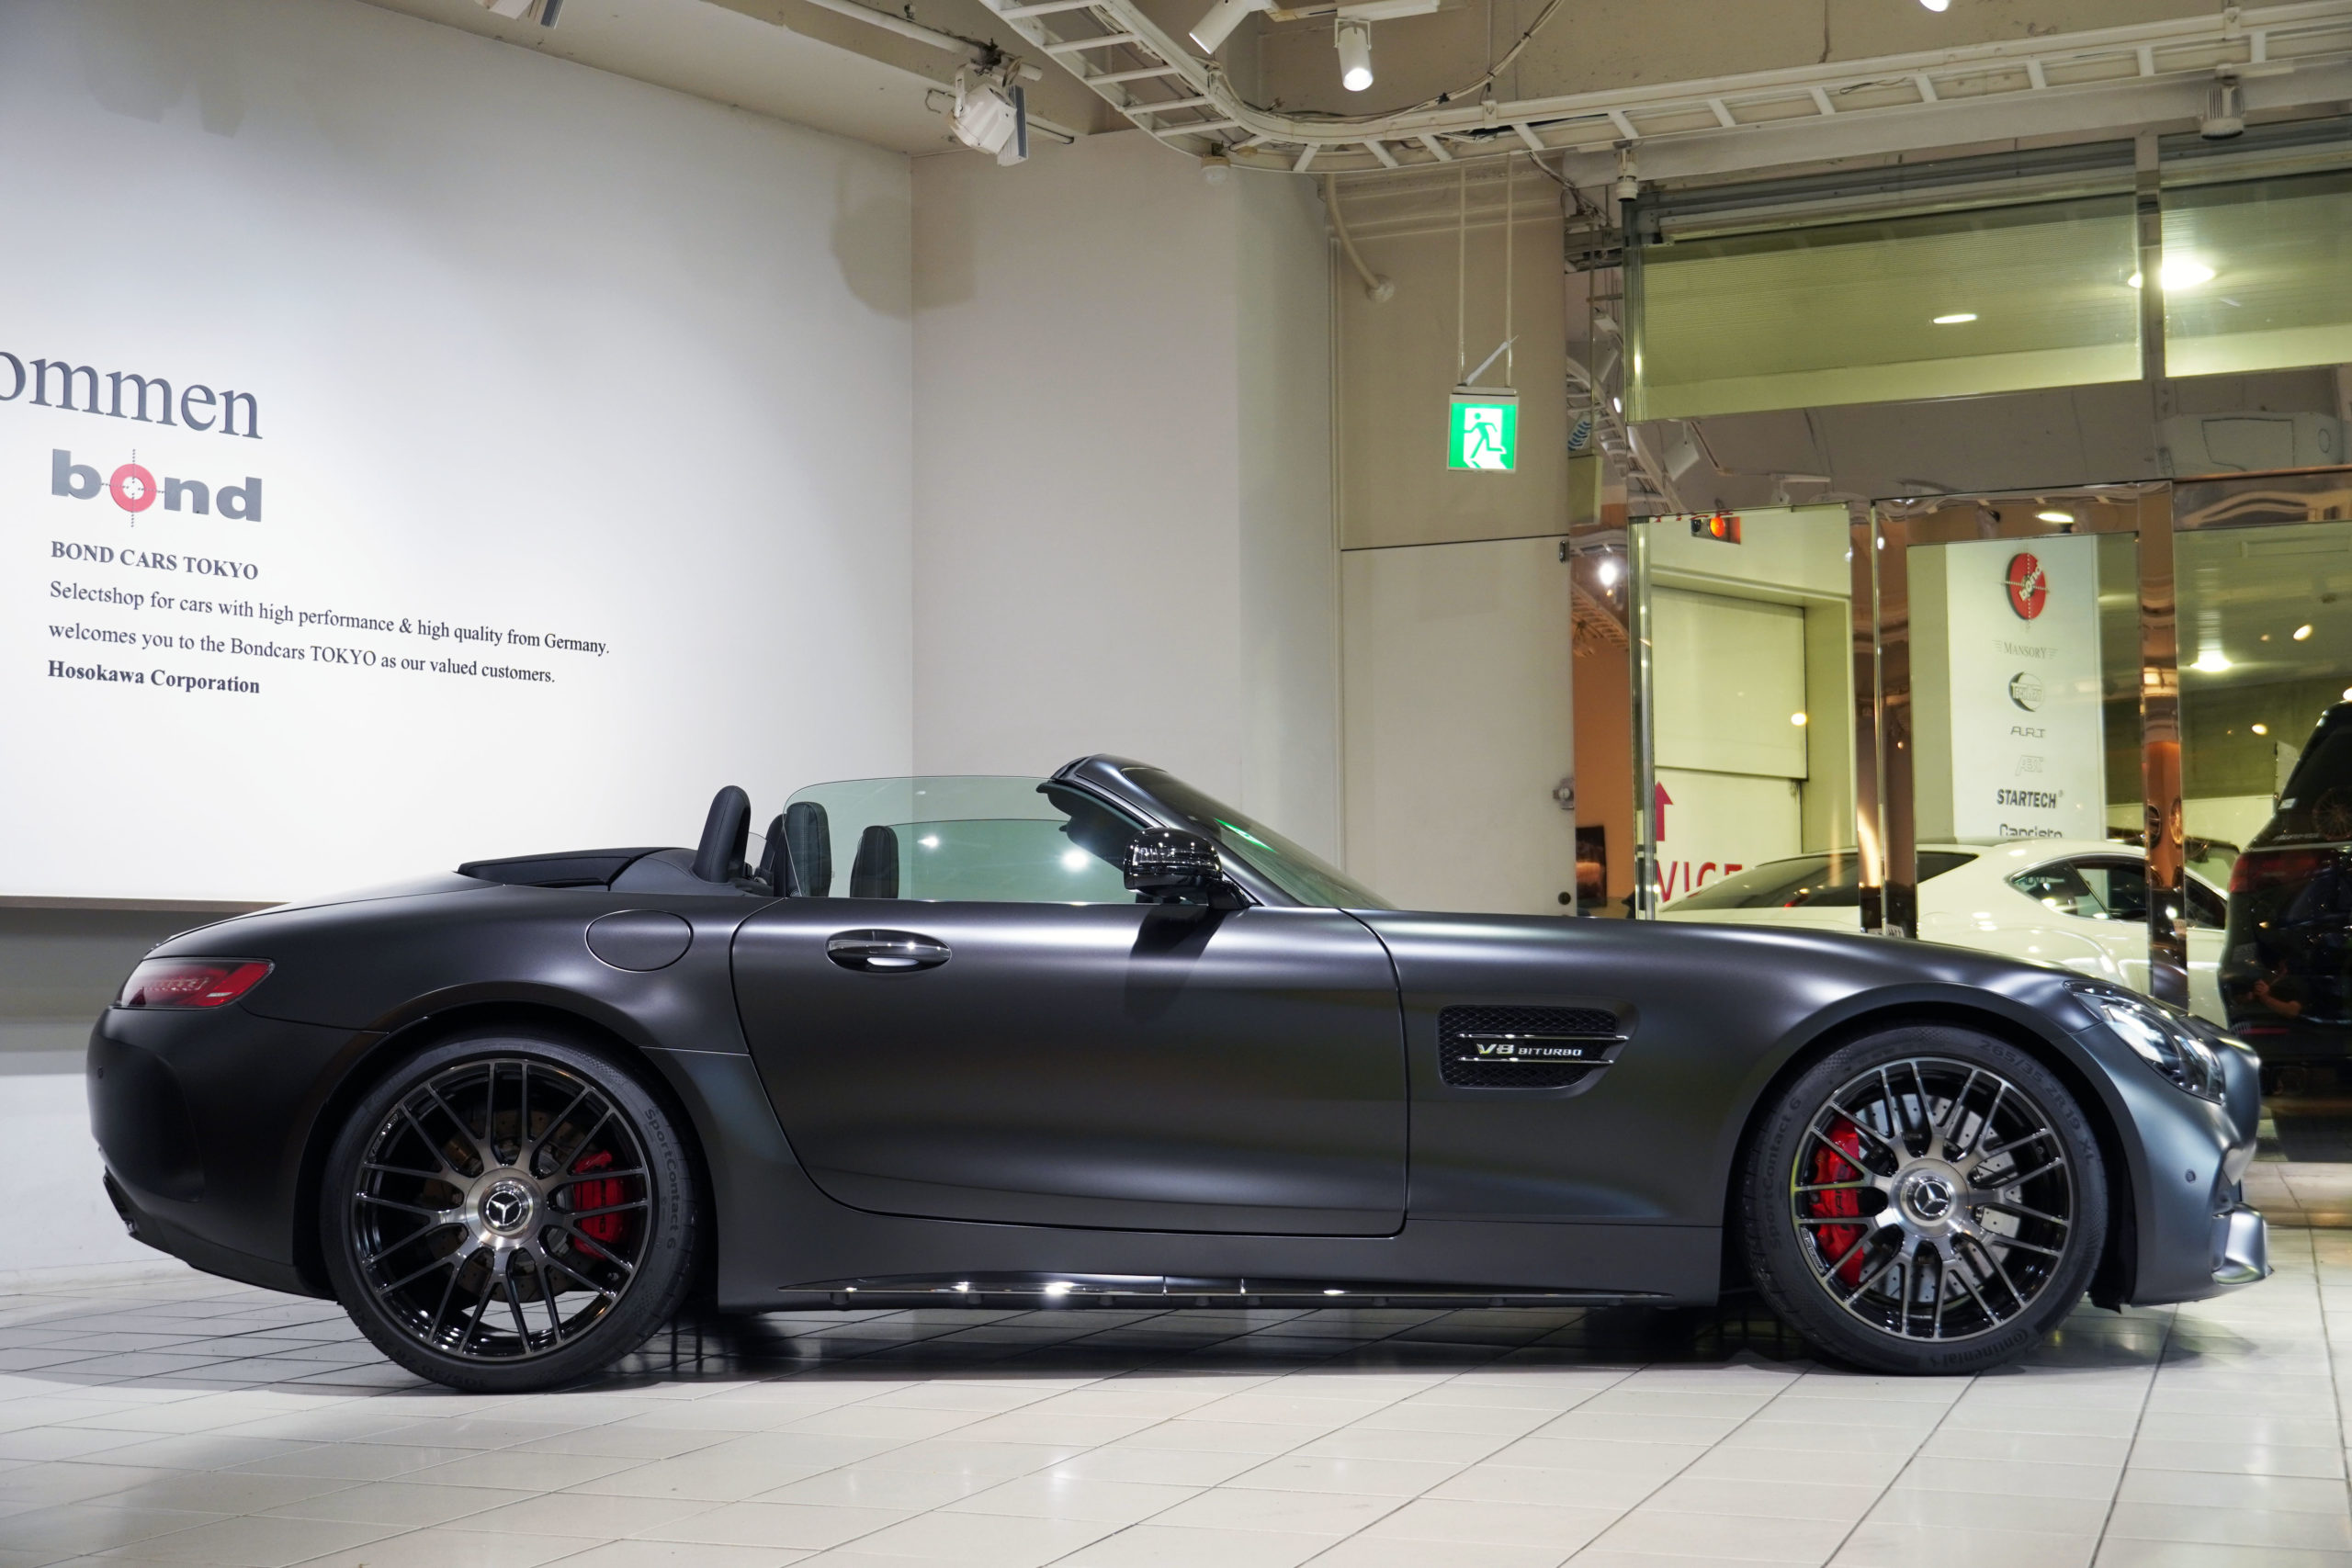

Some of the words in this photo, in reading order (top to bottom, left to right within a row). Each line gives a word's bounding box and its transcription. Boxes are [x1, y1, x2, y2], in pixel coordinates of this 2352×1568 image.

[51, 448, 262, 523] bond
[51, 540, 115, 564] BOND
[119, 548, 178, 571] CARS
[182, 556, 259, 581] TOKYO
[50, 580, 145, 611] Selectshop
[150, 591, 175, 610] for
[179, 599, 213, 614] cars
[218, 599, 254, 618] with
[258, 602, 294, 626] high
[298, 609, 395, 632] performance
[398, 617, 413, 635] &
[417, 618, 450, 641] high
[453, 625, 503, 648] quality
[506, 628, 541, 648] from
[544, 633, 610, 658] Germany.
[48, 622, 137, 645] welcomes
[141, 633, 174, 650] you
[178, 635, 196, 650] to
[199, 635, 226, 653] the
[230, 637, 306, 660] Bondcars
[310, 645, 377, 667] TOKYO
[380, 656, 397, 669] as
[401, 658, 426, 671] our
[429, 657, 478, 676] valued
[481, 664, 556, 683] customers.
[47, 660, 145, 684] Hosokawa
[150, 669, 260, 694] Corporation
[1996, 788, 2057, 808] STARTECH
[1476, 1043, 1514, 1055] V8
[1518, 1047, 1582, 1056] BITURBO
[645, 1108, 679, 1232] SportContact
[666, 1236, 676, 1250] 6
[1942, 1328, 2030, 1368] Continental
